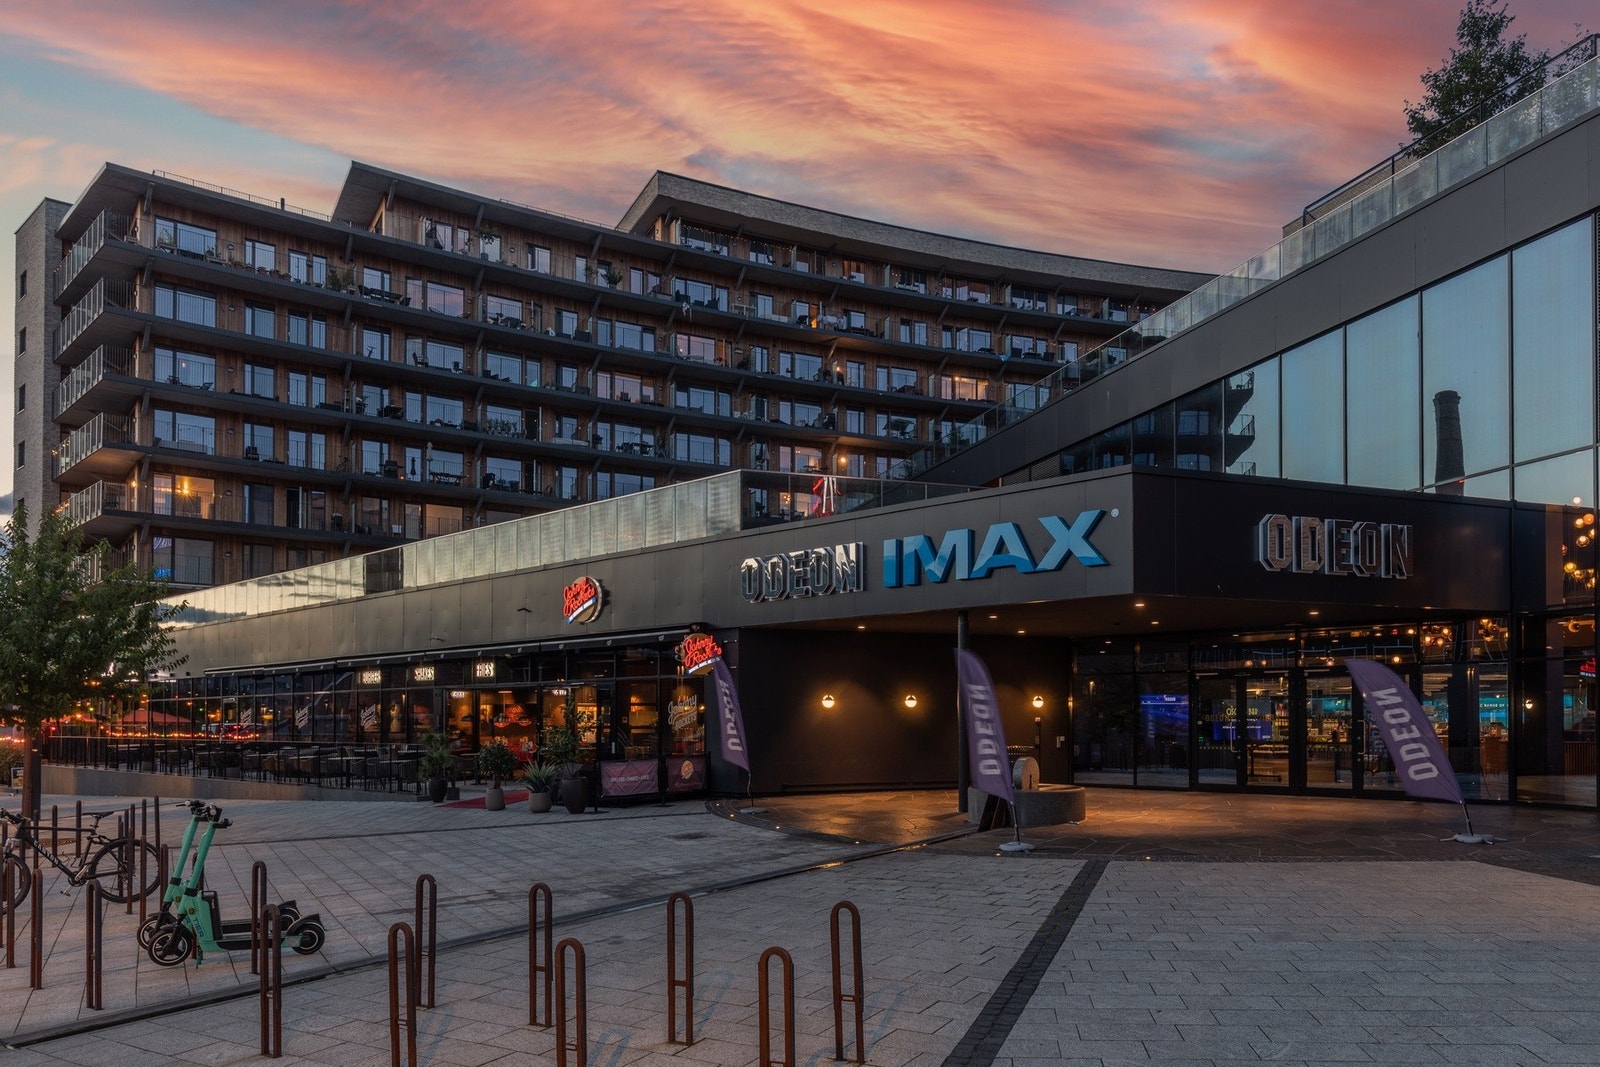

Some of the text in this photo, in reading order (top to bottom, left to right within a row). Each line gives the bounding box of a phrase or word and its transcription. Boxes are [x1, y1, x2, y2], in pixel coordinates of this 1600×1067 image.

[740, 508, 1110, 604] ODEON IMAX
[1258, 513, 1414, 580] ODEON
[476, 662, 494, 678] FRIES
[685, 635, 716, 667] Johnny
[667, 694, 697, 726] Johnny
[967, 683, 1001, 776] ODEON
[1371, 687, 1439, 781] ODEON
[193, 916, 205, 938] TIER
